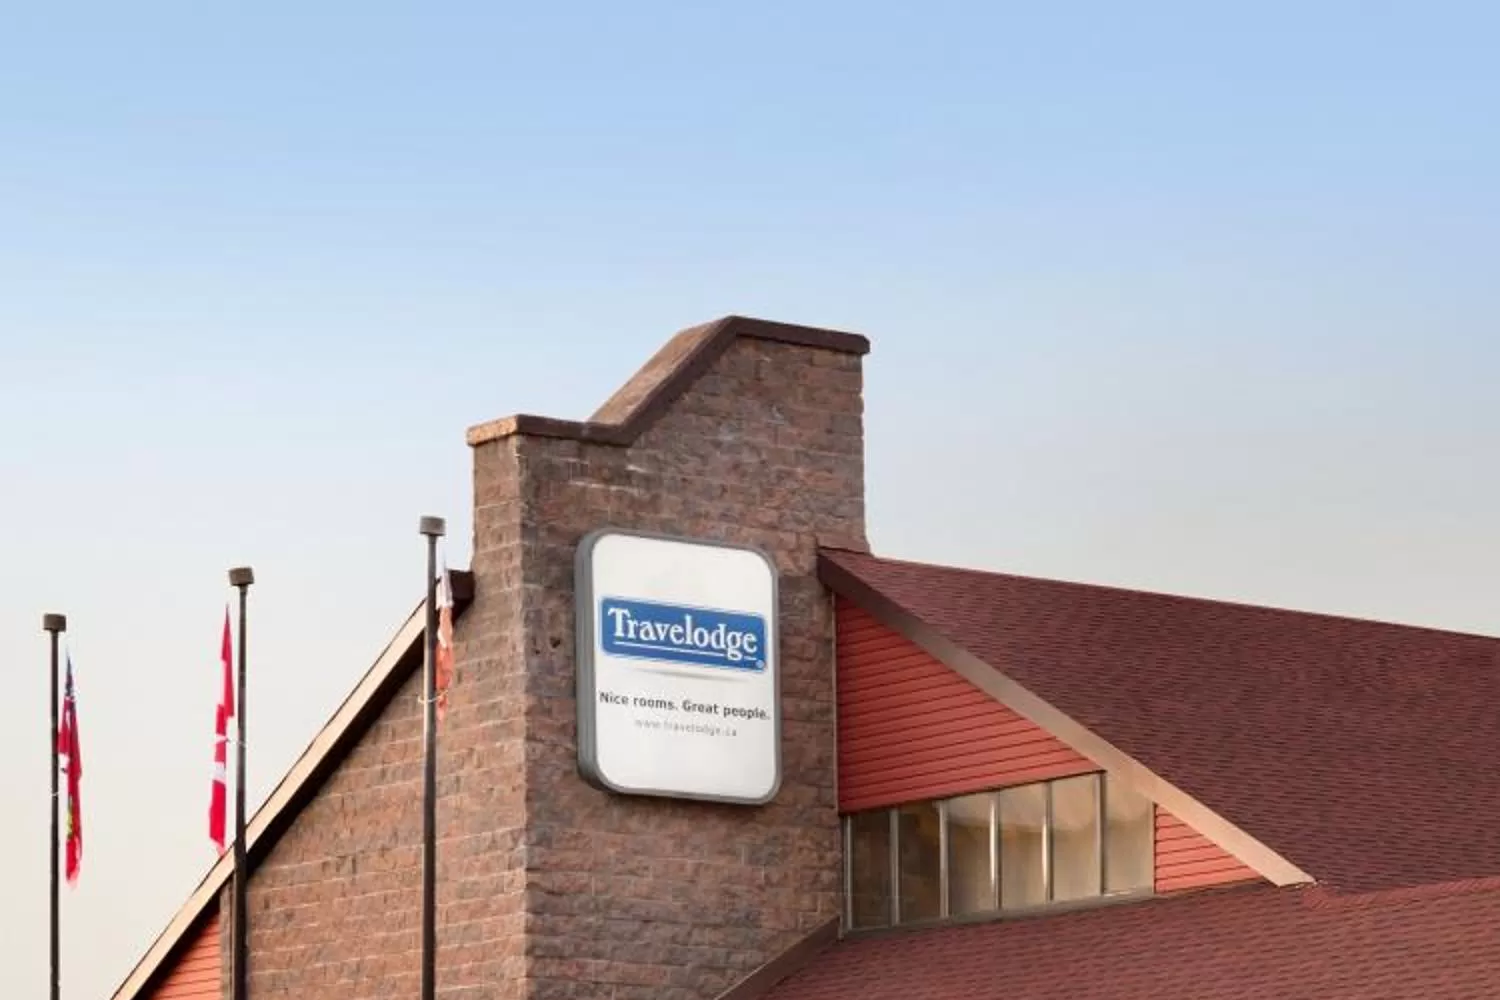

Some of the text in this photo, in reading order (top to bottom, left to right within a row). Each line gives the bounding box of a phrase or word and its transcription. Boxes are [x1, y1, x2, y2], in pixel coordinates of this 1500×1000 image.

[608, 607, 757, 660] Travelodge
[600, 691, 771, 720] Nice rooms. Great people.
